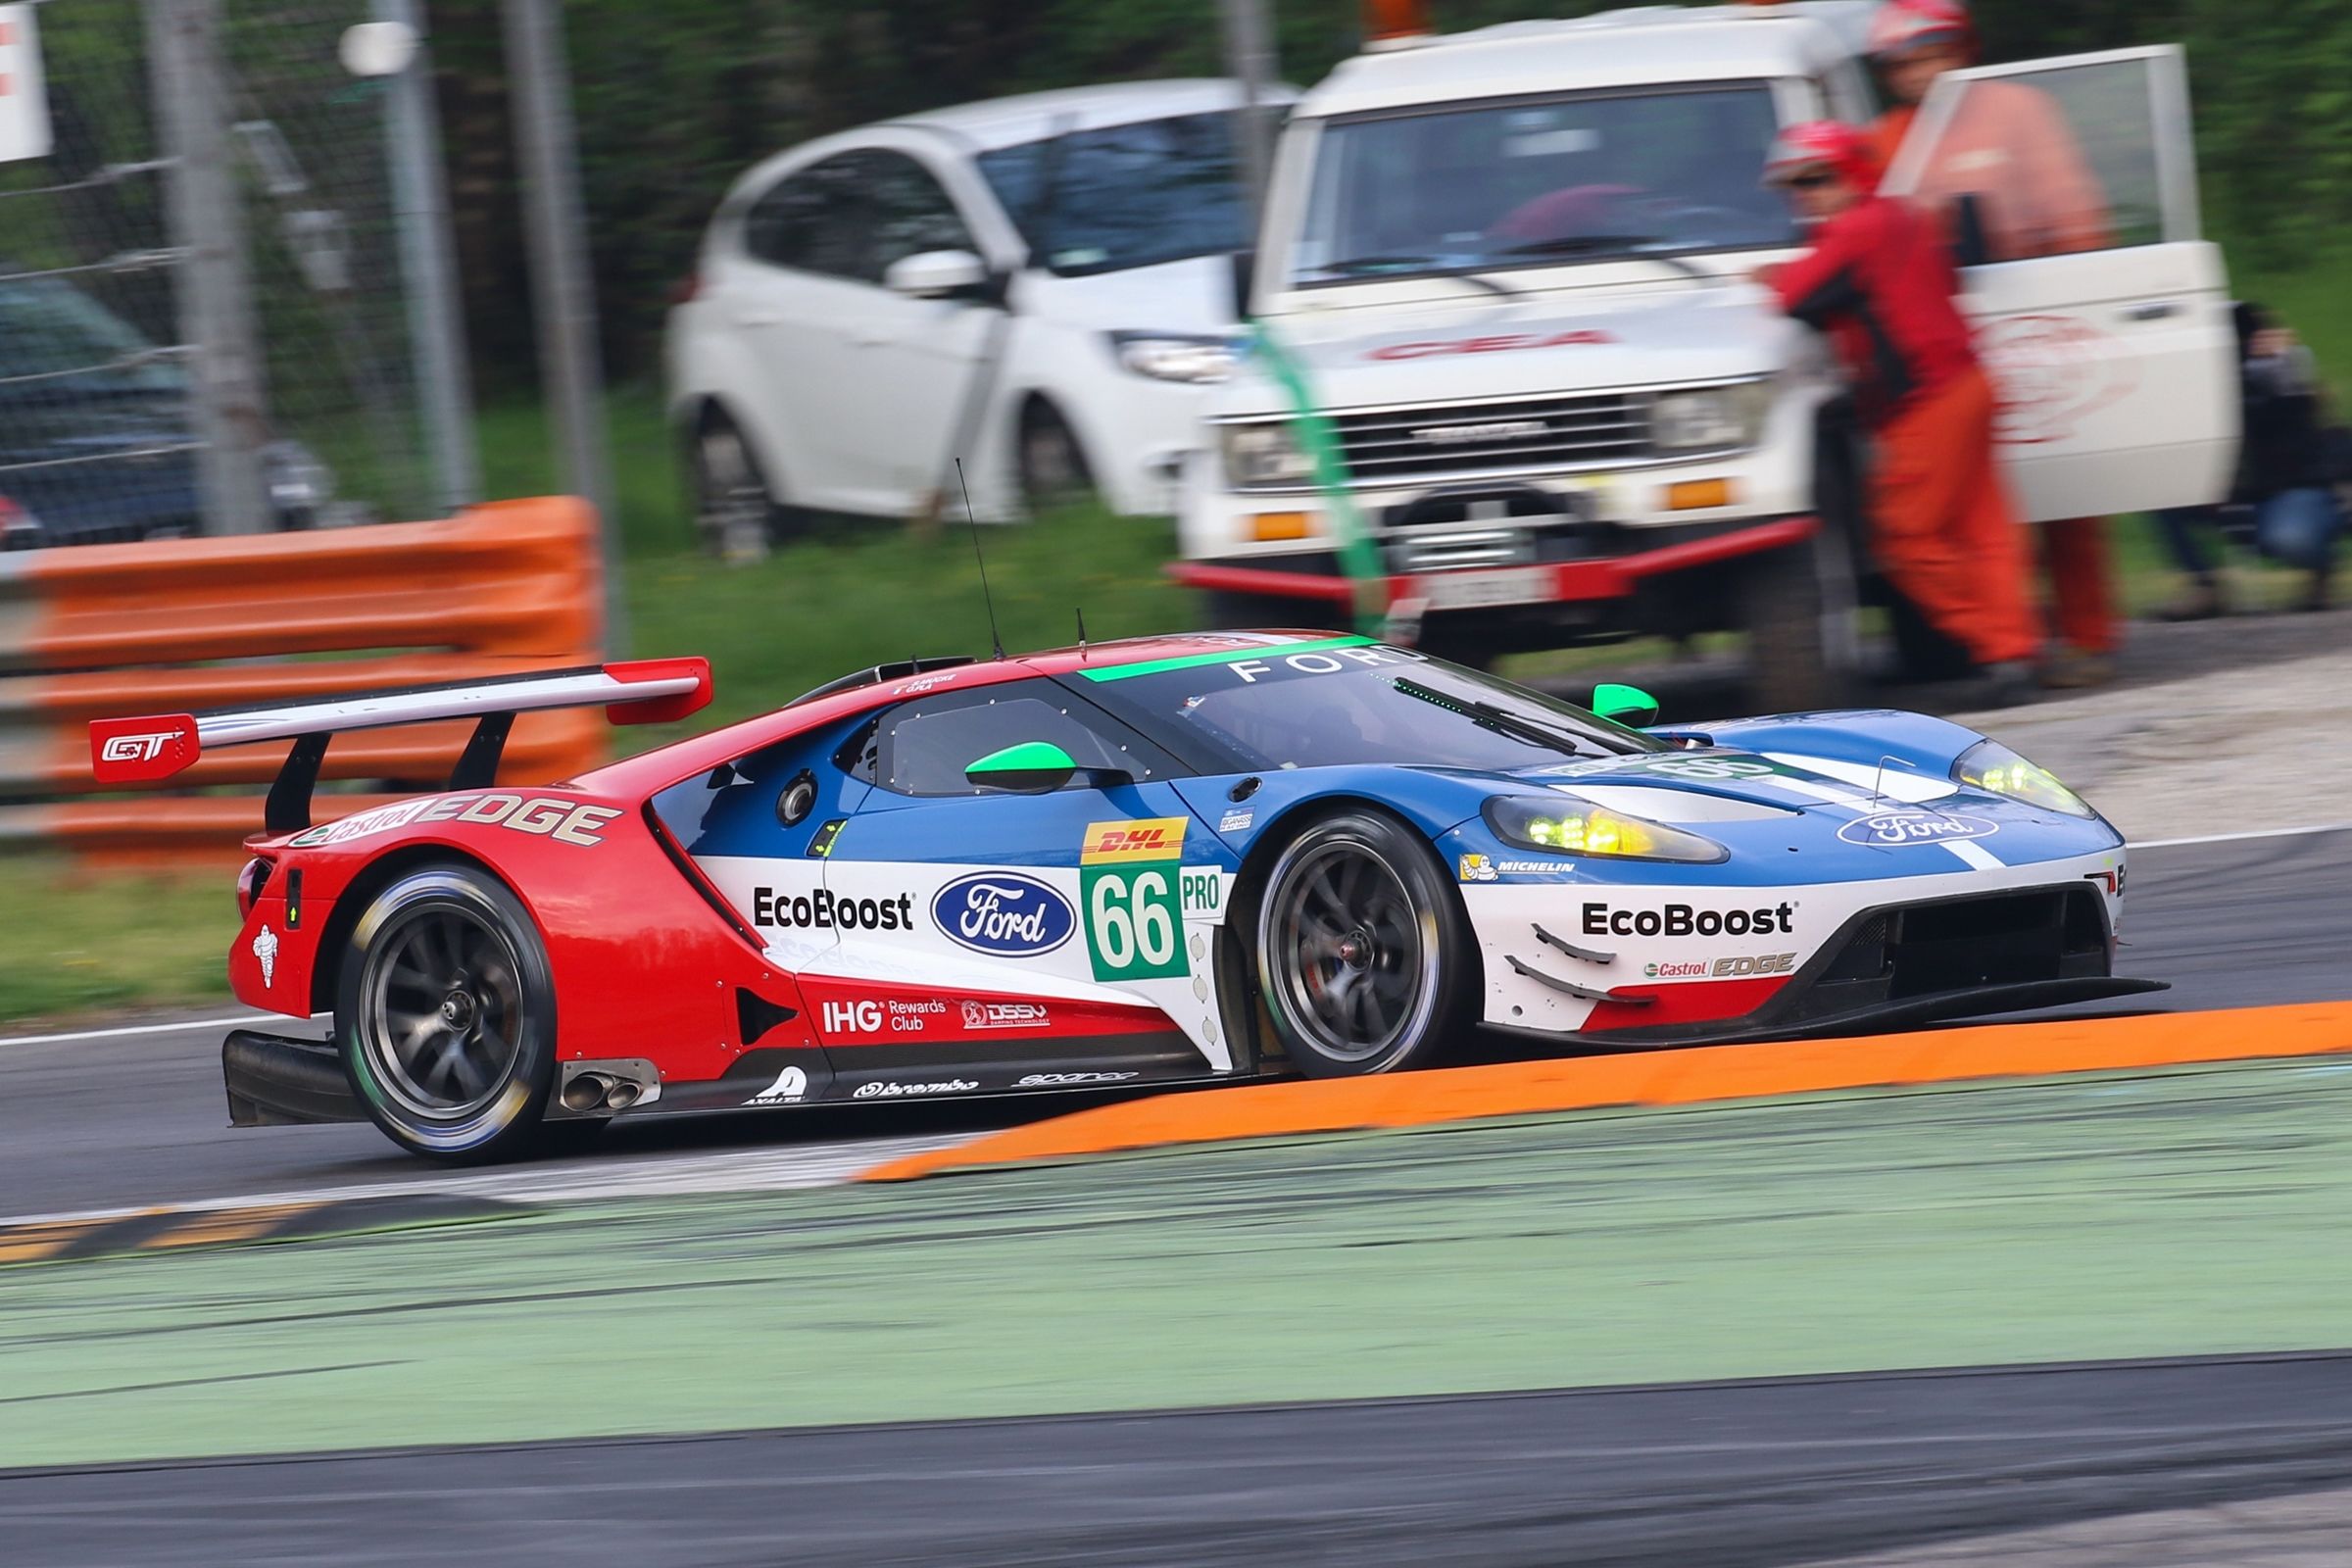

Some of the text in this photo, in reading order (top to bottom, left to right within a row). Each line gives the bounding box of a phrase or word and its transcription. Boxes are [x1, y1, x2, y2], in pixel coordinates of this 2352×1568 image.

[1227, 643, 1430, 683] FORD
[101, 730, 186, 762] GT
[1645, 759, 1775, 779] 66
[327, 794, 625, 848] Castrol EDGE
[1867, 814, 1975, 843] Ford
[1097, 828, 1166, 854] DHL
[1497, 860, 1576, 873] MICHELIN
[1182, 873, 1220, 911] PRO
[753, 886, 915, 932] EcoBoost
[959, 882, 1048, 945] Ford
[1091, 870, 1176, 969] 66
[1582, 901, 1794, 937] EcoBoost
[1658, 952, 1799, 977] Castrol EDGE
[821, 1000, 883, 1034] IHG
[888, 999, 947, 1015] Rewards
[986, 1004, 1047, 1019] DSSV
[891, 1015, 924, 1032] Club
[882, 1078, 980, 1097] brembo
[1017, 1071, 1141, 1086] sparco
[740, 1096, 803, 1105] AXALTA
